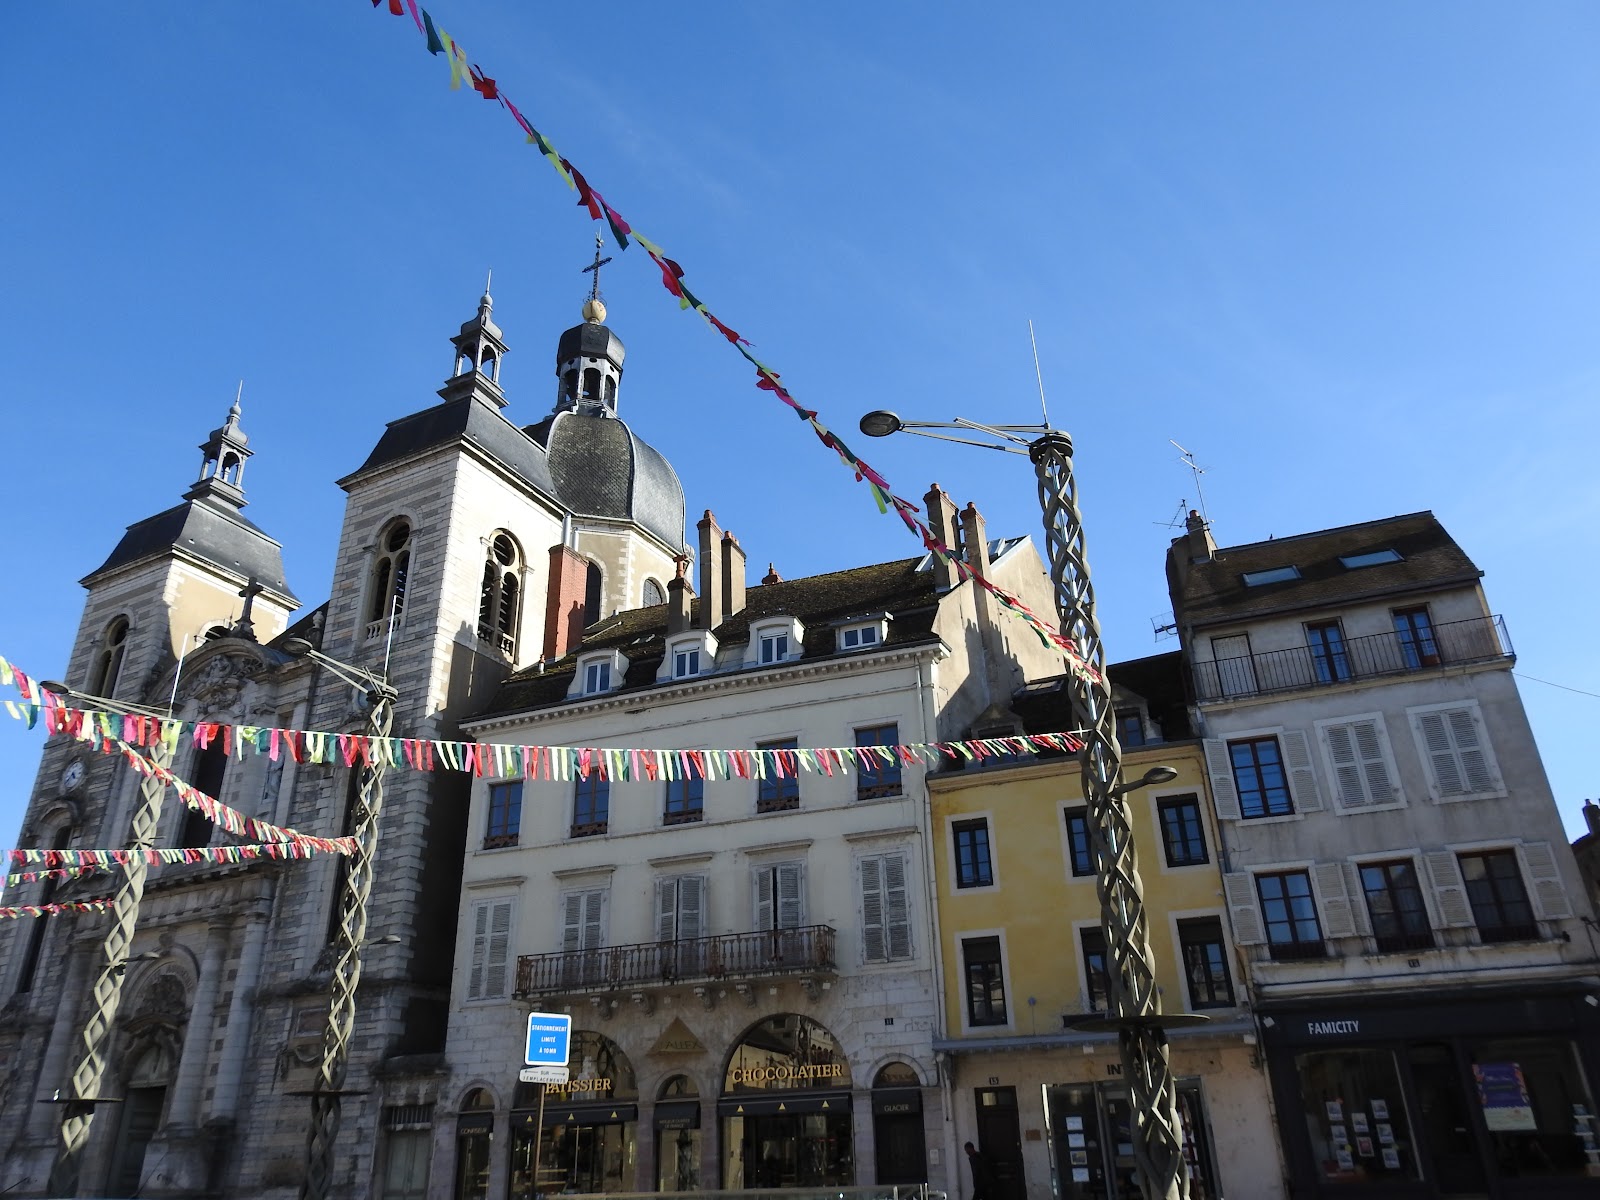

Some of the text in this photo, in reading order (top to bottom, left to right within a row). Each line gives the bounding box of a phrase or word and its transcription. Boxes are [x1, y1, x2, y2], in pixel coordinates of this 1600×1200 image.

[1308, 1020, 1359, 1034] FAMICITY
[732, 1063, 842, 1082] CHOCOLATIER
[884, 1103, 910, 1112] GLACIER
